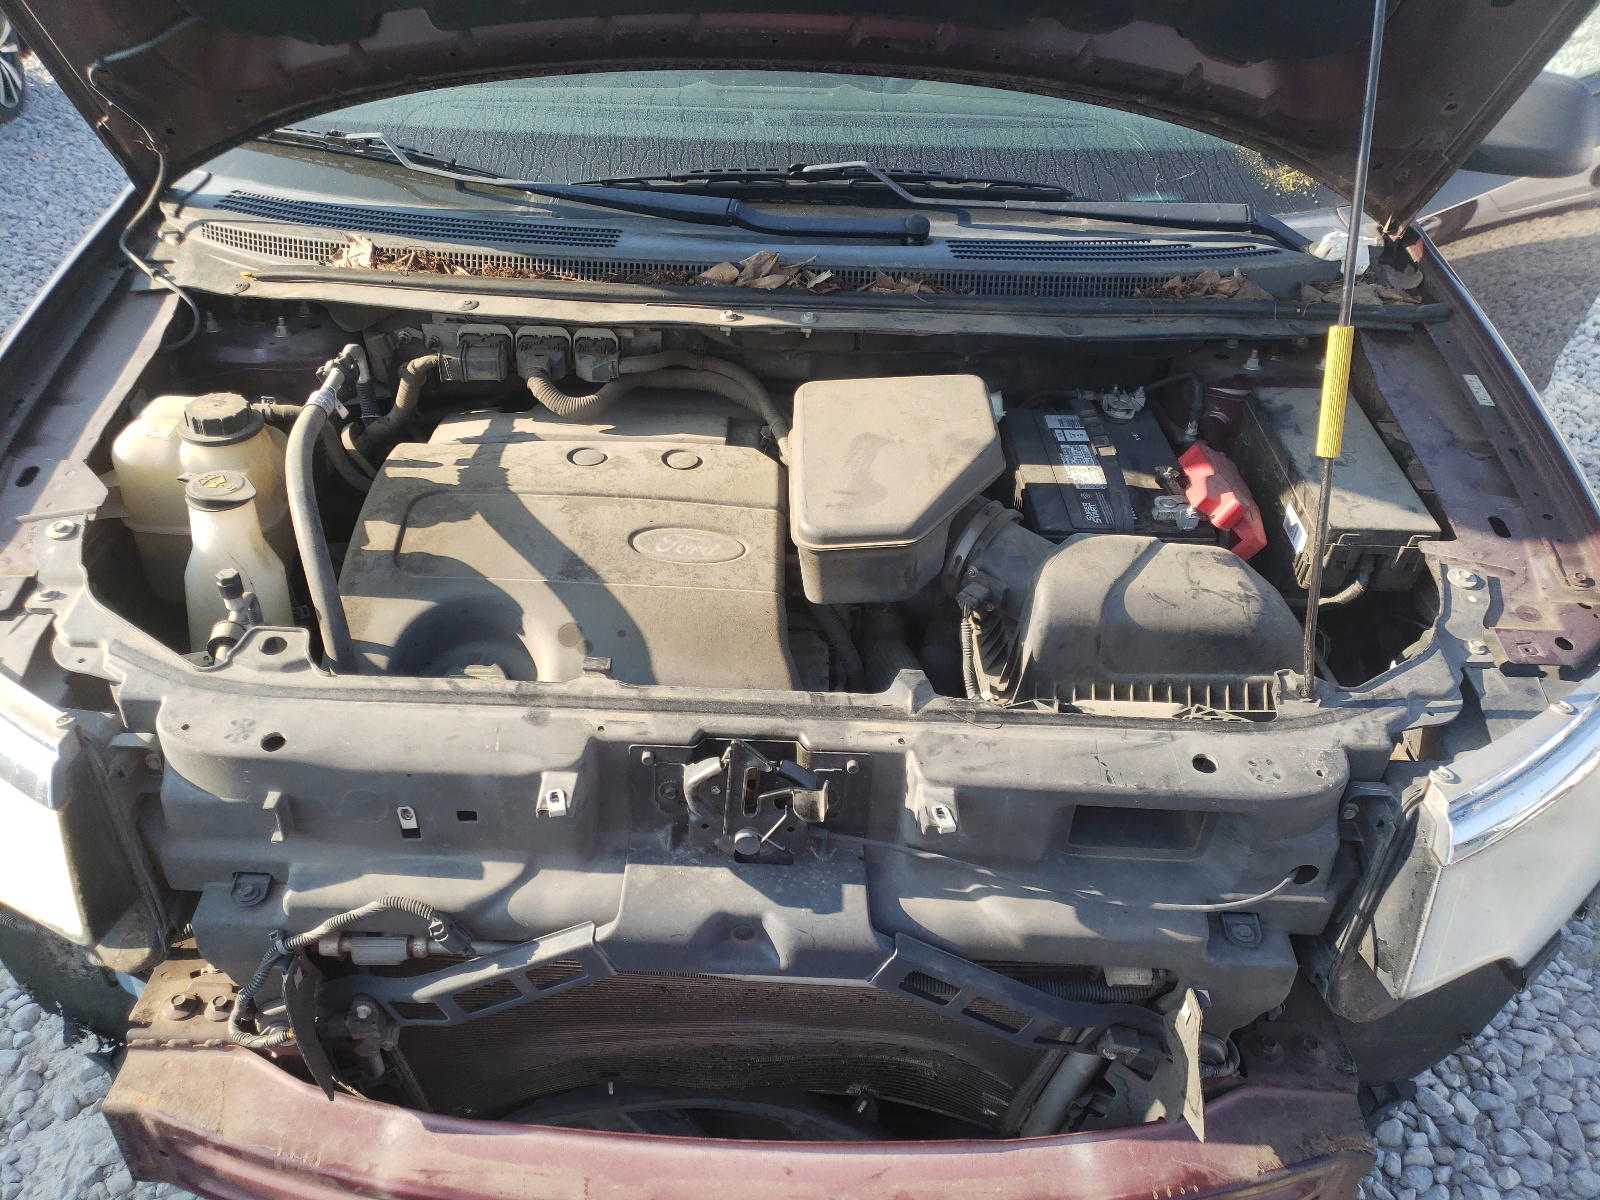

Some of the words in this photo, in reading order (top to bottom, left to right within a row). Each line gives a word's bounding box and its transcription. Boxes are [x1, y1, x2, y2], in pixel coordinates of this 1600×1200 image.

[1081, 502, 1092, 521] SUPER
[1089, 503, 1103, 524] START
[655, 533, 721, 555] Ford
